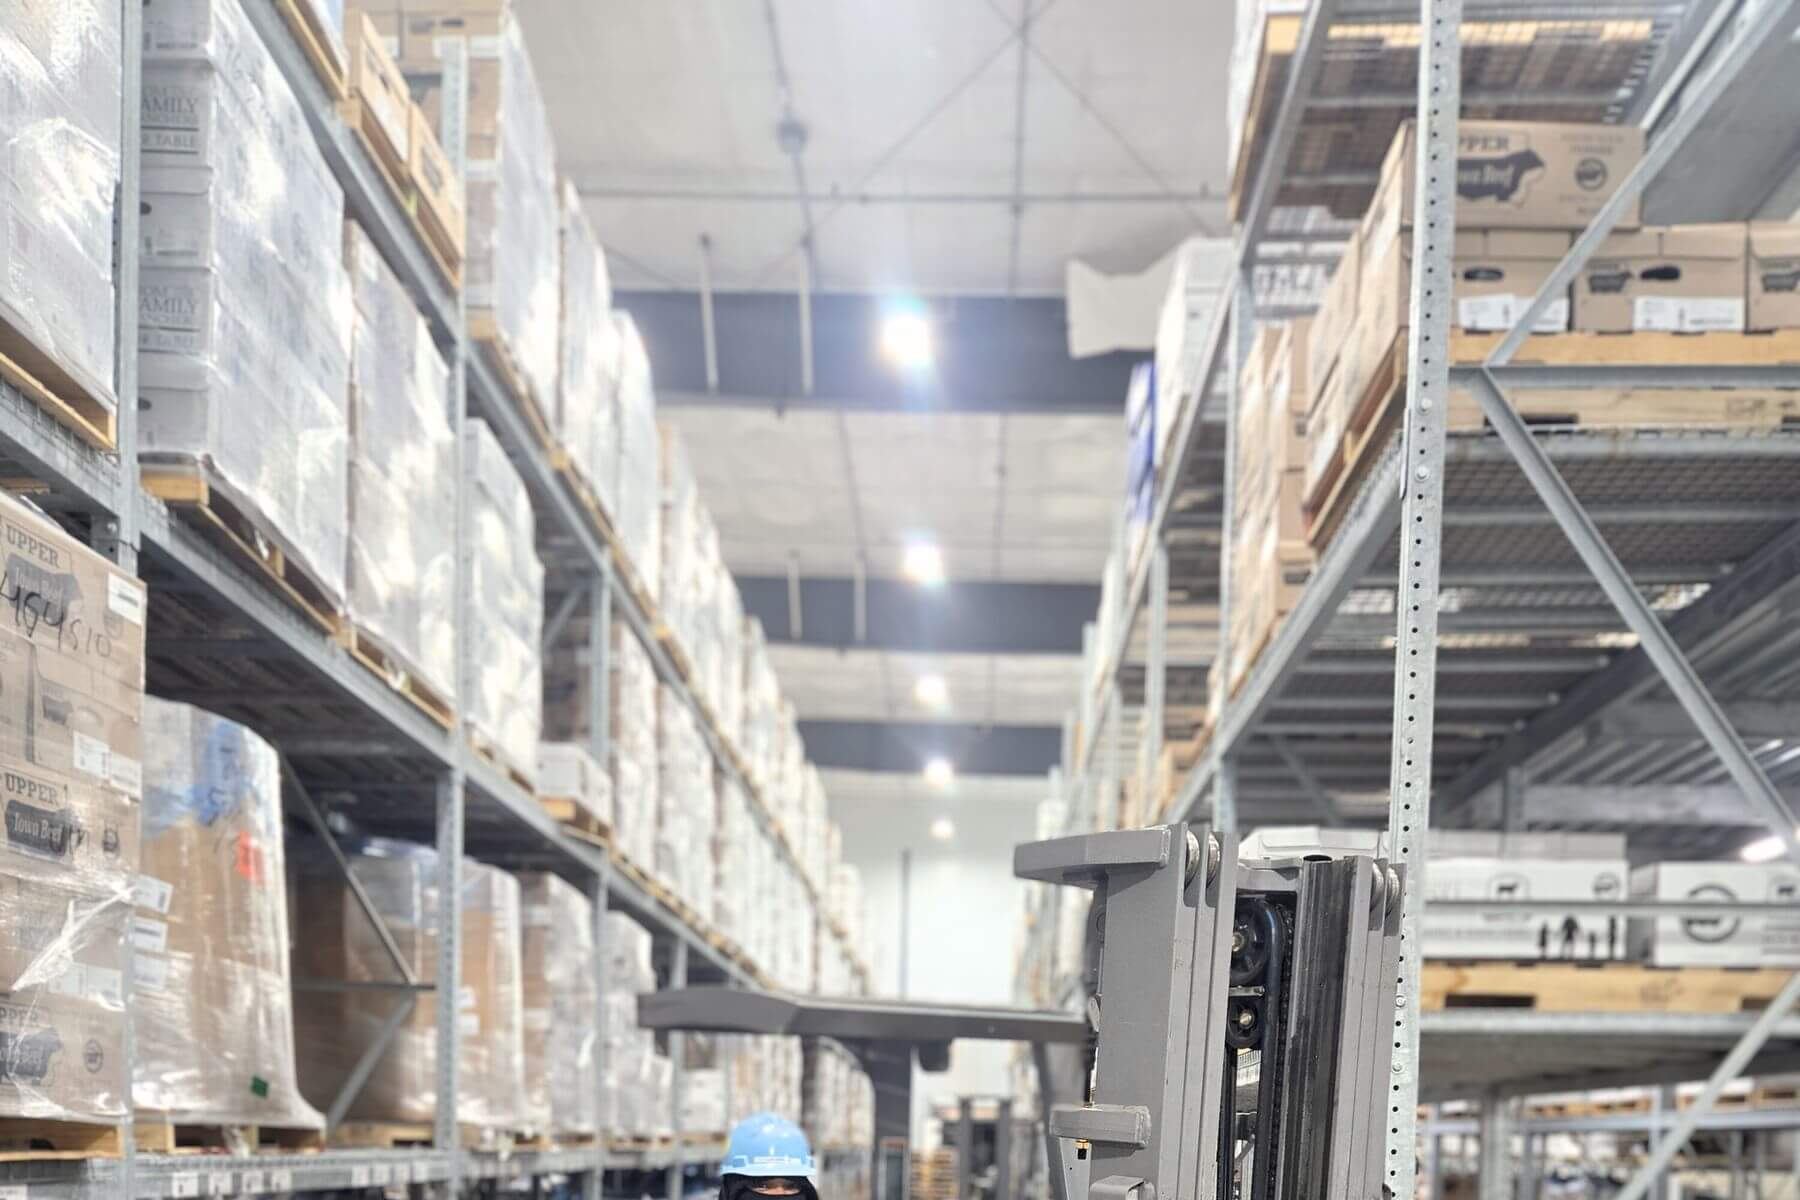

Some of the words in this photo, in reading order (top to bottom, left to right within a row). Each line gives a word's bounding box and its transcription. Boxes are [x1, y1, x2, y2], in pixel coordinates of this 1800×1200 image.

[141, 97, 199, 113] AMILY
[1457, 134, 1509, 149] PPER
[139, 297, 199, 314] AMILY
[6, 523, 60, 569] UPPER
[5, 772, 60, 806] UPPER
